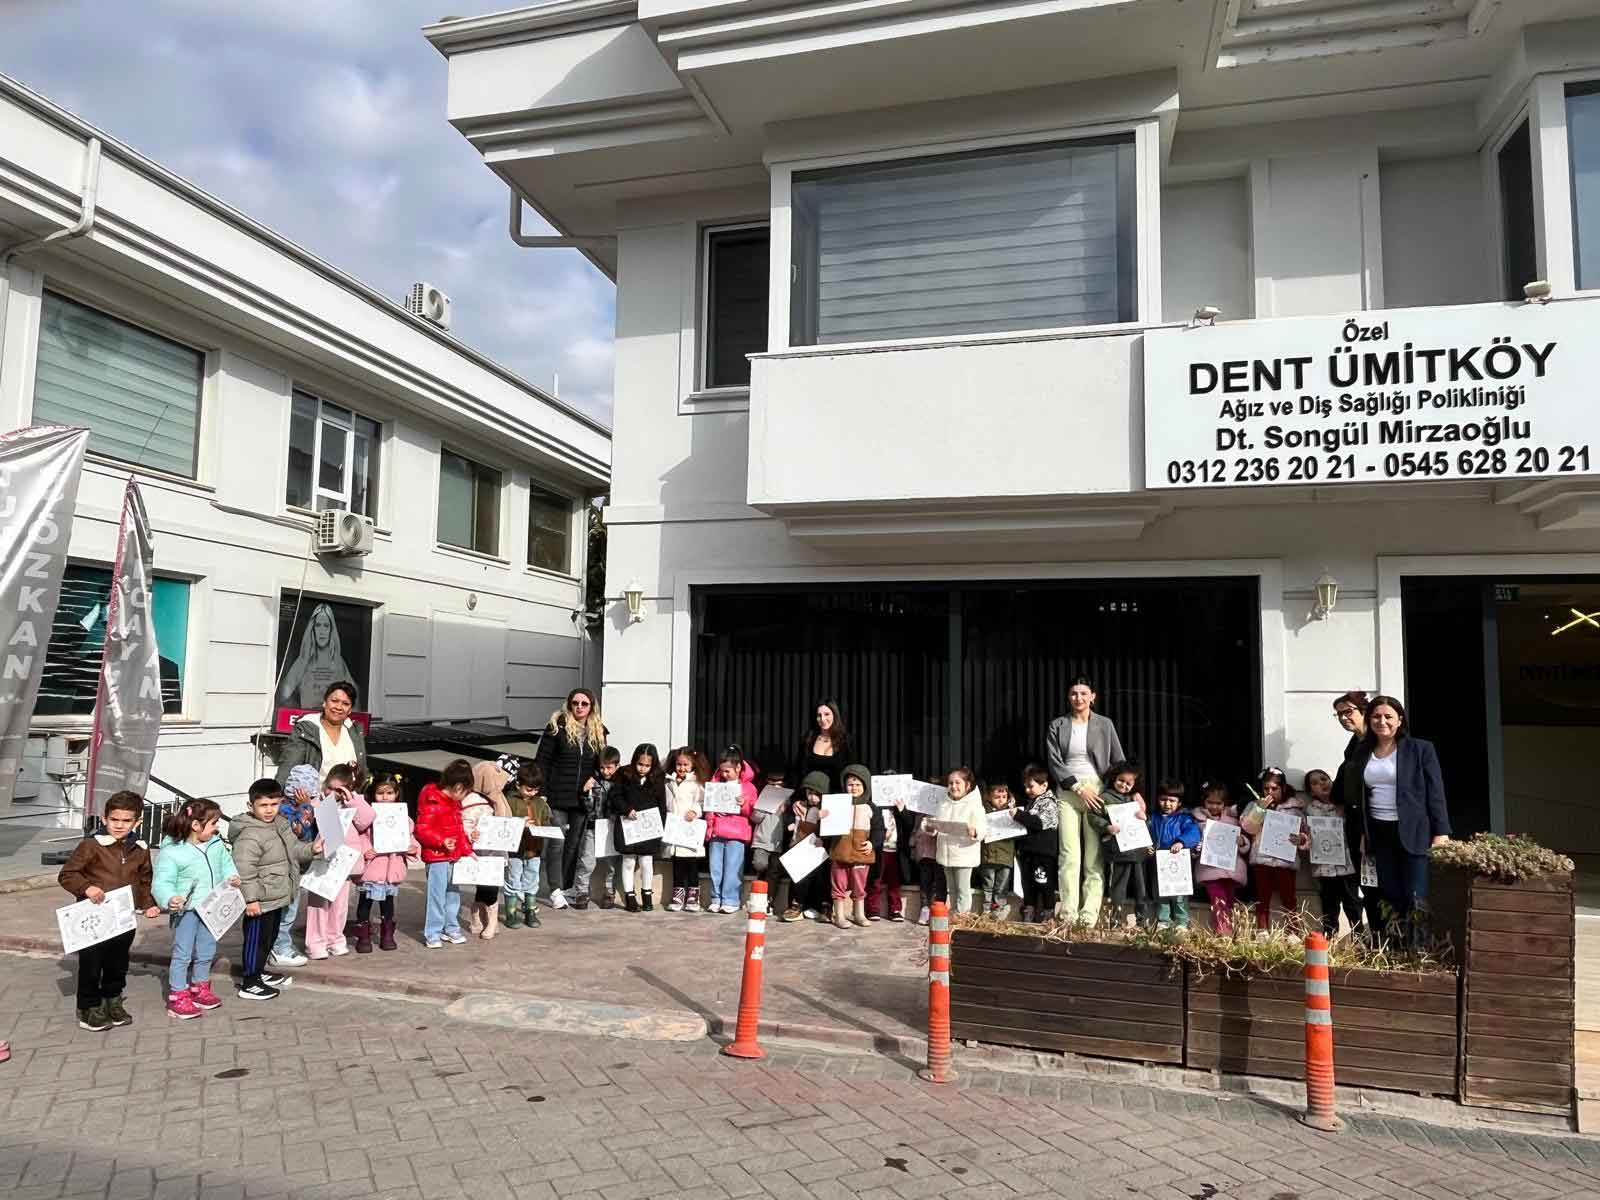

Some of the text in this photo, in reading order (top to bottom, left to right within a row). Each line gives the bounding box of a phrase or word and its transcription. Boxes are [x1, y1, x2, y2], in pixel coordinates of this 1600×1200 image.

[1342, 318, 1389, 343] Özel
[1189, 336, 1558, 395] DENT ÜMİTKÖY
[1219, 385, 1526, 423] Ağız ve Diş Sağlığı Polikliniği
[1216, 415, 1531, 454] Dt. Songül Mirzaoğlu
[1167, 444, 1590, 484] 0312 236 20 21 - 0545 628 20 21
[3, 512, 60, 681] ÖZKAN
